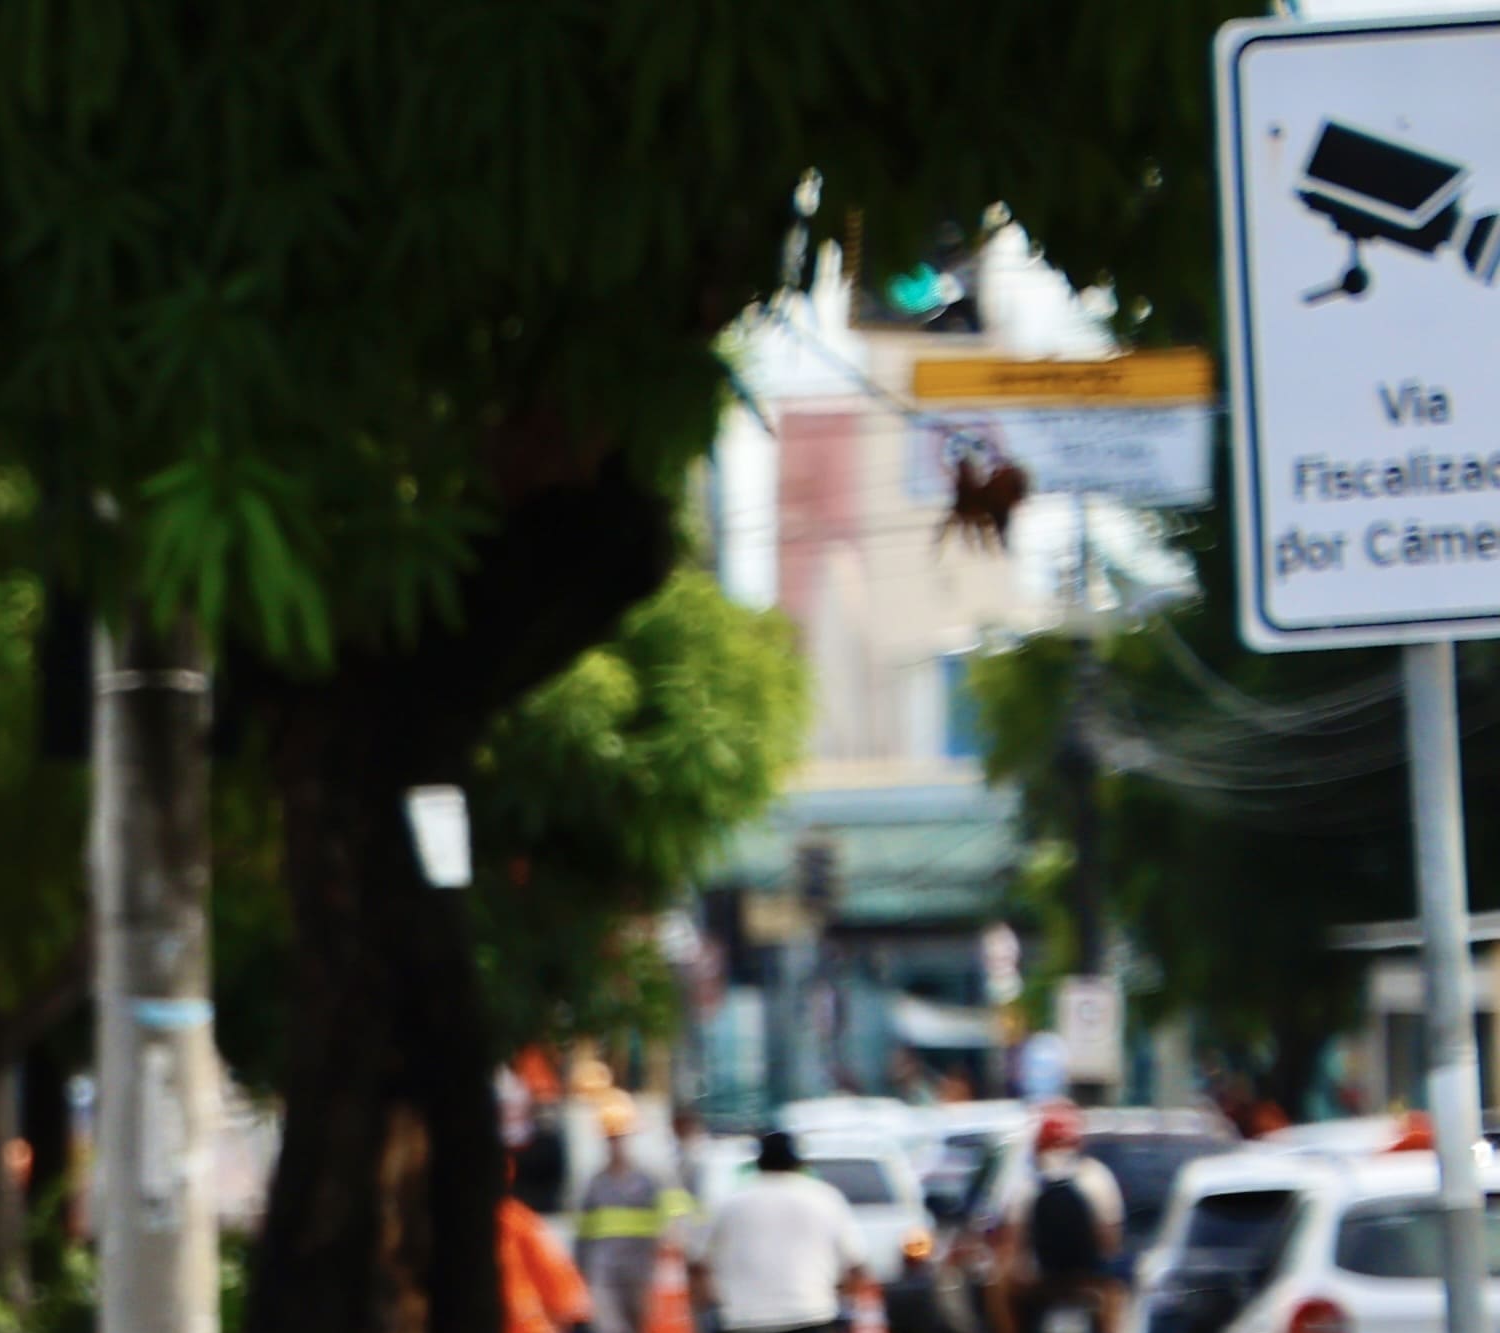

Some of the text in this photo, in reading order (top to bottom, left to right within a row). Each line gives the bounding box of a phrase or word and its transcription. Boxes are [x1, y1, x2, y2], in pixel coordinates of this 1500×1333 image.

[1376, 379, 1450, 426] Via
[1276, 517, 1500, 583] por Câme
